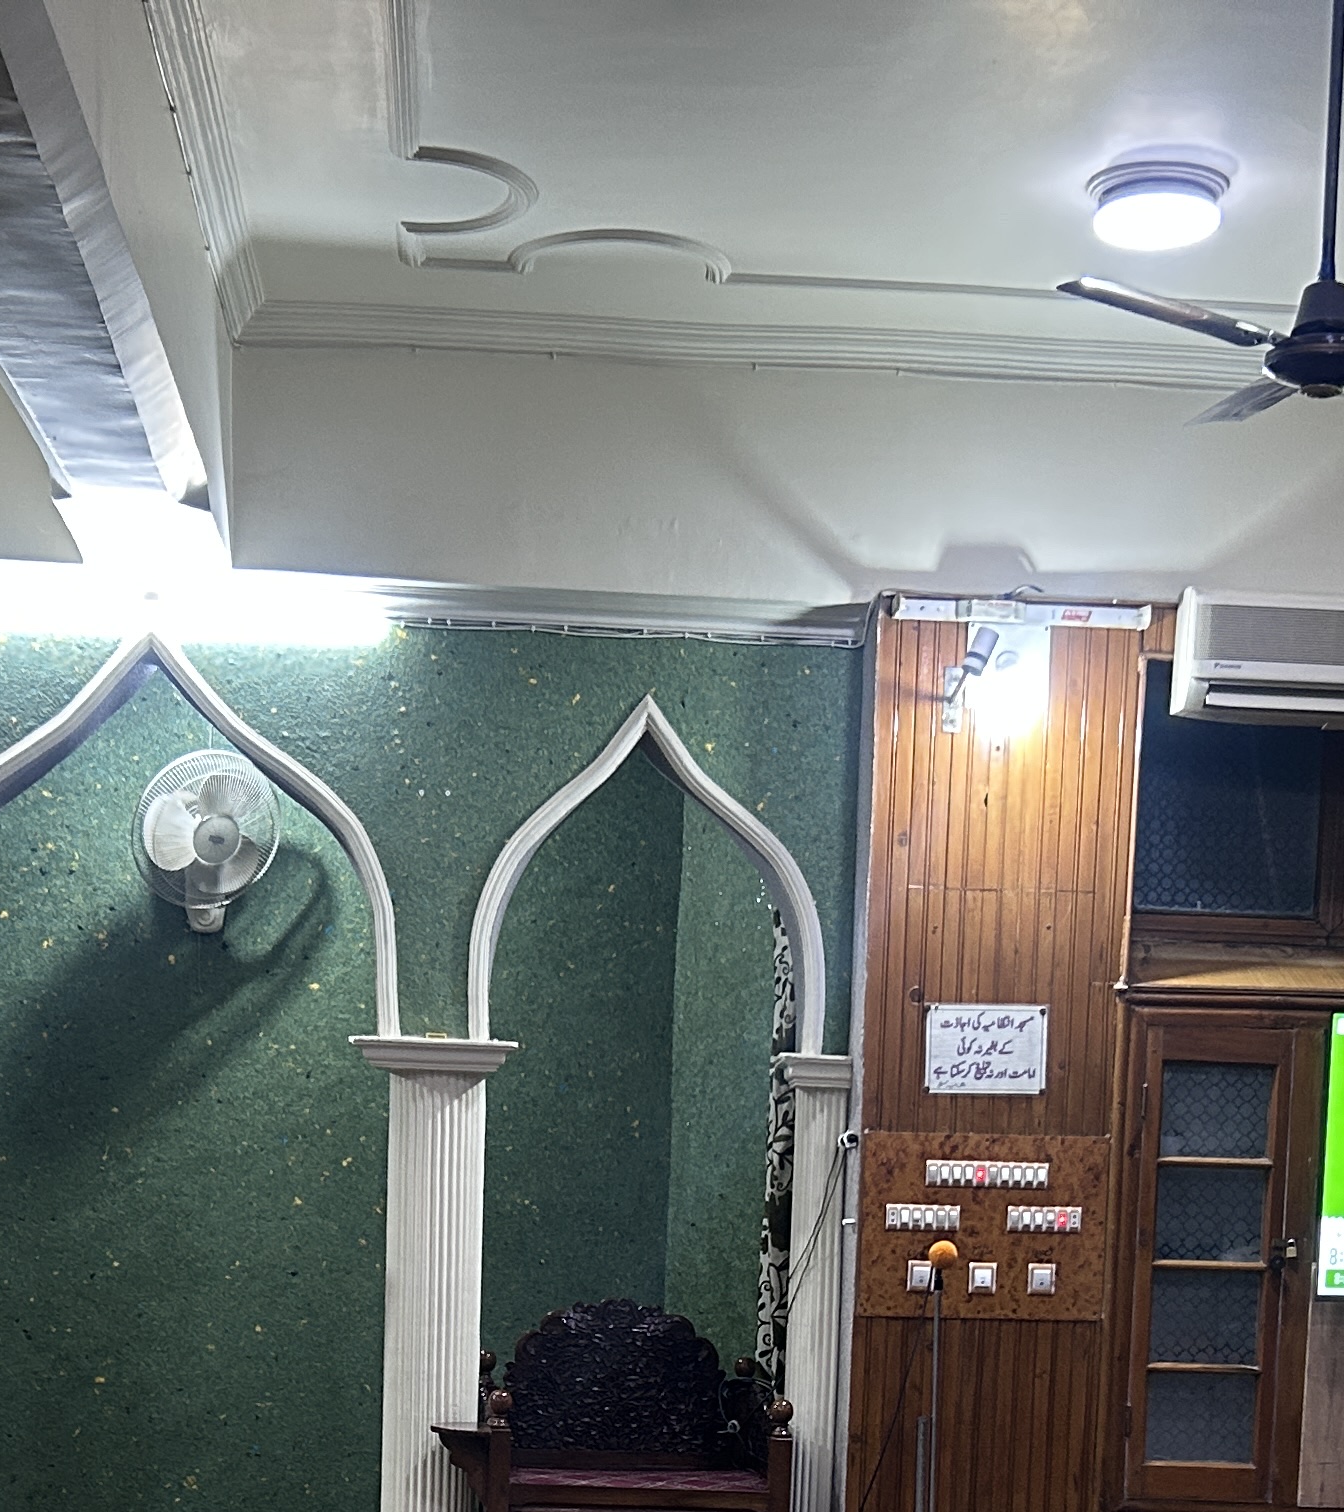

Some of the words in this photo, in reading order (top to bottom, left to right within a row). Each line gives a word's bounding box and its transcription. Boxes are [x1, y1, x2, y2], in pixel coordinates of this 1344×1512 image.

[972, 1011, 985, 1030] کی
[998, 1039, 1014, 1054] کے
[933, 1066, 948, 1080] ہے
[994, 1068, 1008, 1079] اور
